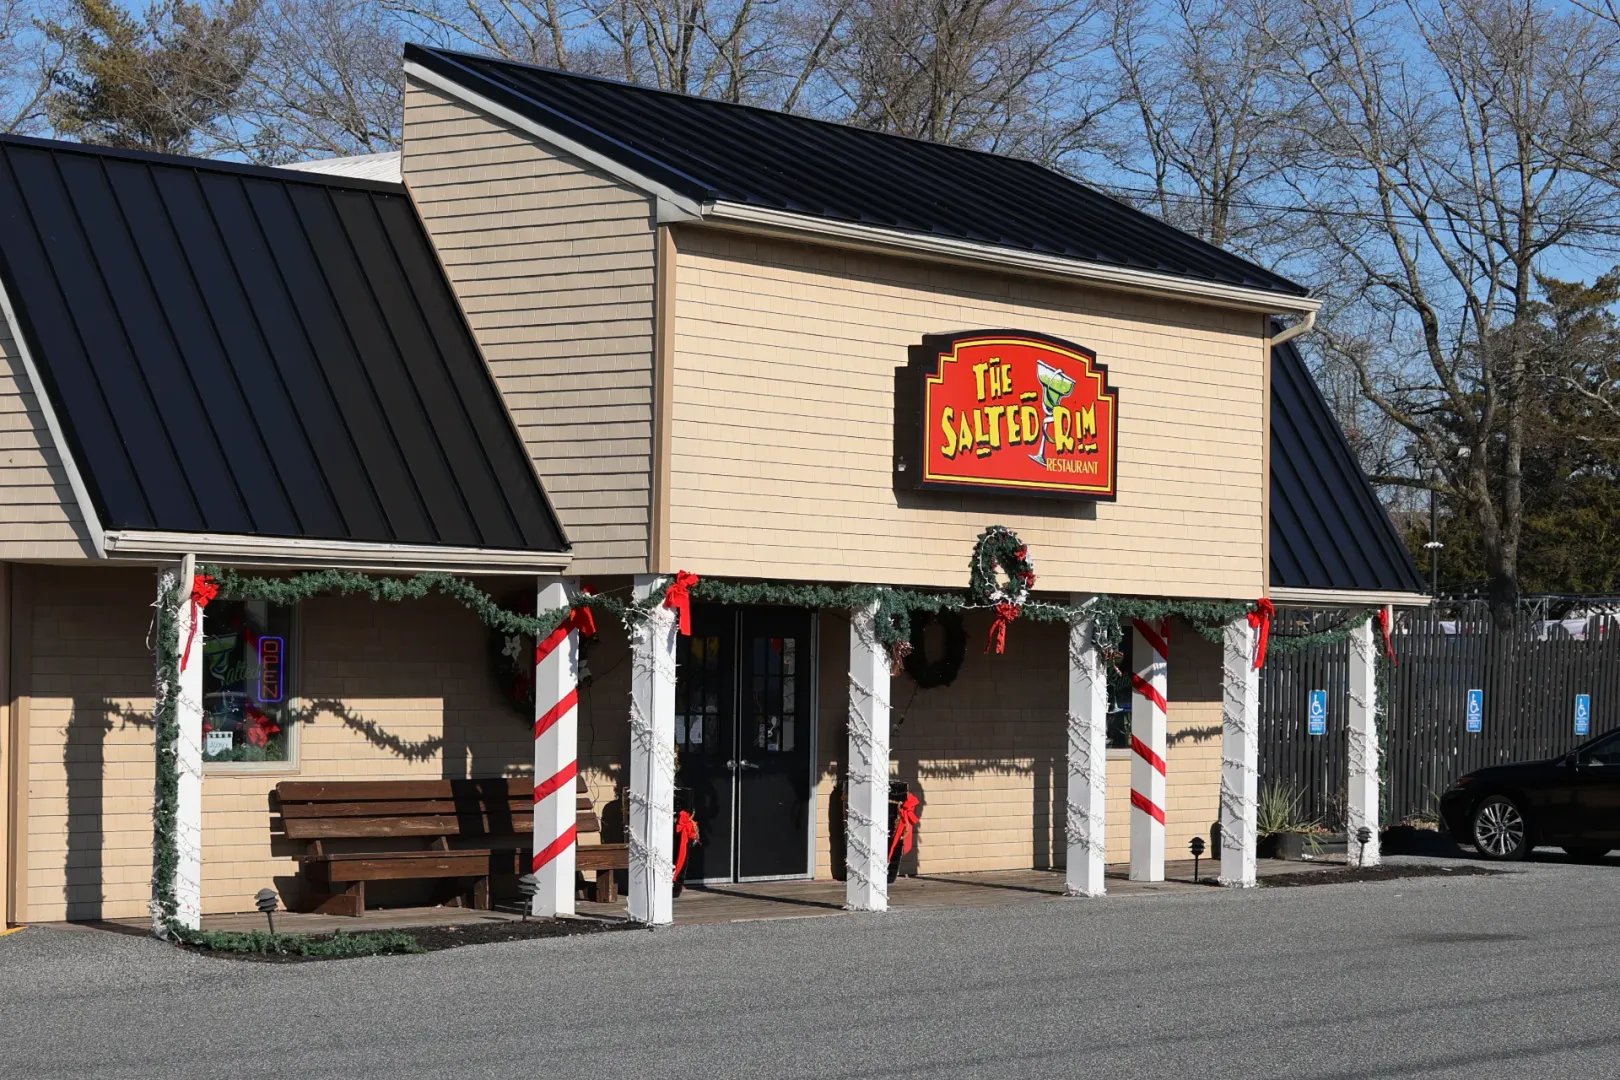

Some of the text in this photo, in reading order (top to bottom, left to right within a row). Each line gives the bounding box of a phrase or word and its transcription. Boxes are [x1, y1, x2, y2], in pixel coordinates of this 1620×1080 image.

[972, 358, 1013, 402] THE
[940, 402, 1098, 459] SALTED RIM
[1046, 457, 1099, 475] RESTAURANT
[263, 640, 279, 699] OPEN
